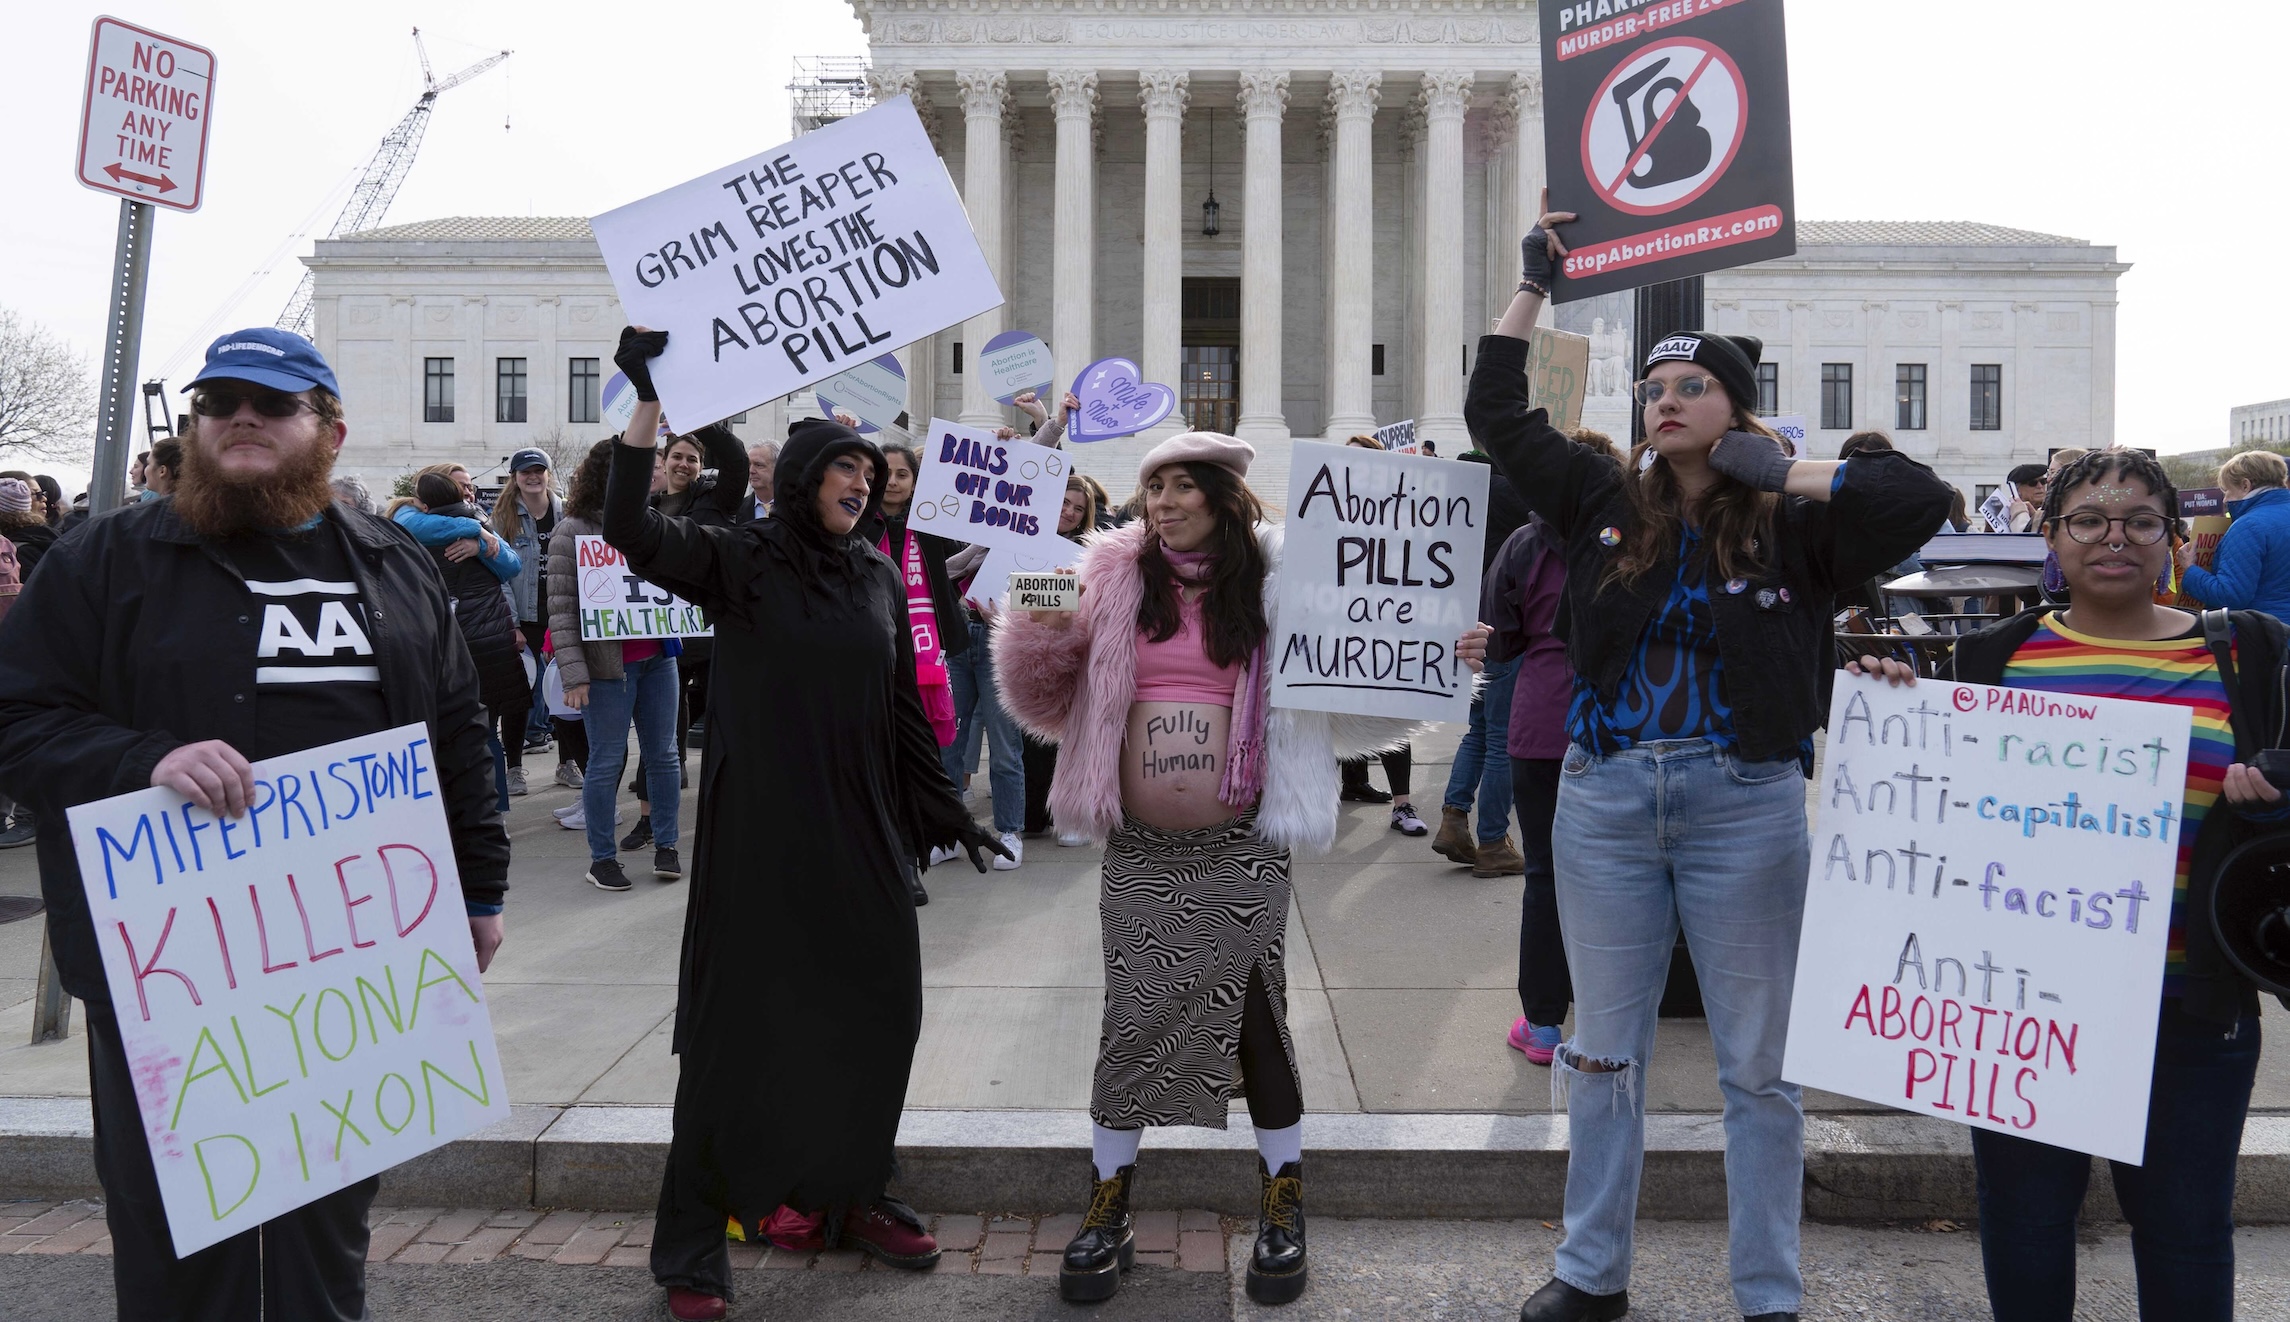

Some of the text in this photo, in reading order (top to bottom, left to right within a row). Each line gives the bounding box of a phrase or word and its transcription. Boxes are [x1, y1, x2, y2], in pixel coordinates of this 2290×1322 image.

[1085, 24, 1346, 39] EQUAL JUSTICE UNDER LAW
[1561, 2, 1693, 56] MURDER-FREE
[133, 41, 175, 79] NO
[100, 67, 199, 121] PARKING
[117, 135, 173, 170] TIME
[121, 111, 172, 142] ANY
[723, 154, 805, 205] THE
[636, 152, 898, 288] GRIM REAPER
[1565, 212, 1778, 273] StopAbortionRx.com
[733, 203, 885, 295] LOVES THE
[712, 230, 940, 362] ABORTION
[782, 312, 891, 374] PILL
[991, 348, 1036, 367] Abortion is
[994, 358, 1037, 376] Healthcare
[1651, 342, 1695, 357] PAAU
[939, 433, 1008, 475] BANS
[1380, 423, 1415, 450] SUPREME
[1778, 426, 1804, 438] 980s
[955, 472, 1033, 506] OFF OUR
[1298, 463, 1474, 530] Abortion
[969, 500, 1039, 536] BODIES
[1016, 578, 1075, 592] ABORTION
[1337, 536, 1455, 588] PILLS
[257, 601, 374, 657] AA
[1347, 597, 1413, 623] are
[1279, 633, 1458, 688] MURDER!
[1147, 710, 1210, 746] Fully
[1143, 750, 1215, 779] Human
[96, 739, 433, 899] MIFEPRISTONE
[117, 843, 438, 1021] KILLED
[1893, 932, 2062, 1010] Anti-
[170, 948, 480, 1130] ALYONA
[1845, 983, 2079, 1075] ABORTION
[1905, 1048, 2038, 1130] PILLS
[194, 1041, 490, 1221] DIXON
